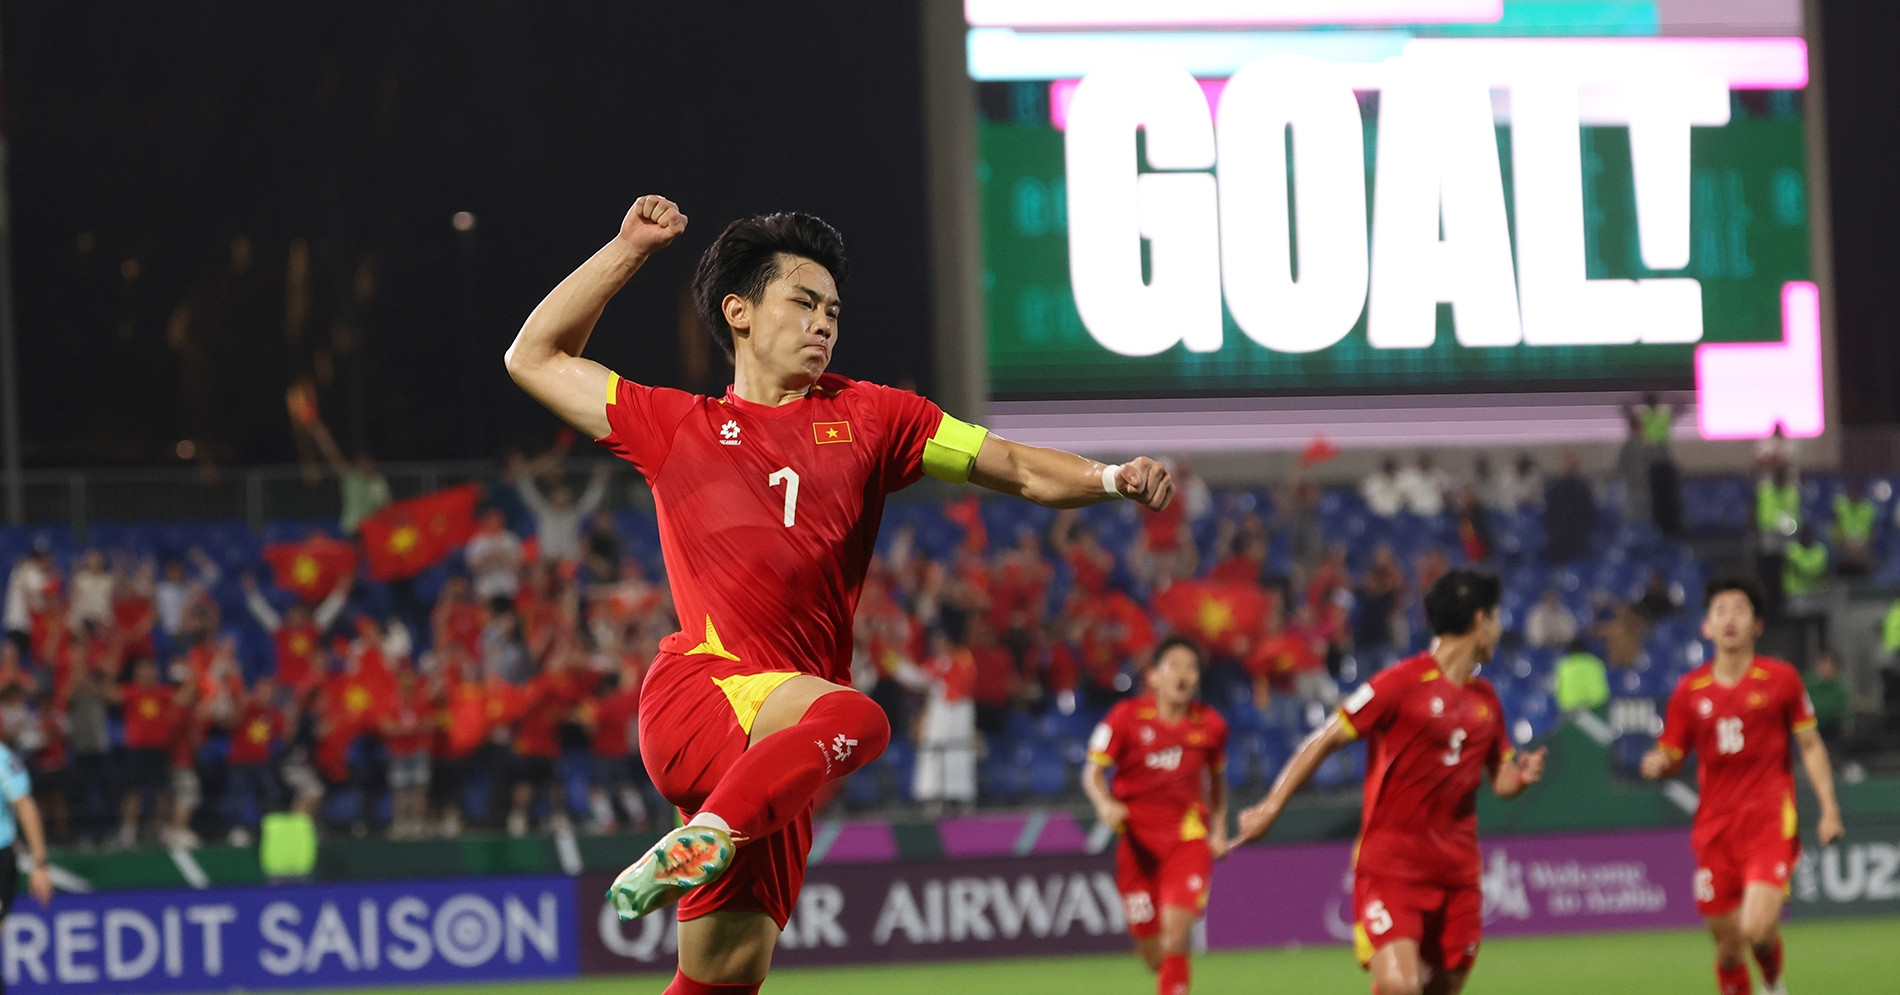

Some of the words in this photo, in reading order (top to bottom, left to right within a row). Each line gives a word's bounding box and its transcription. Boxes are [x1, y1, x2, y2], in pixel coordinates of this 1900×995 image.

[1064, 55, 1730, 356] GOAL!
[769, 466, 800, 528] 7
[1716, 716, 1745, 755] 16
[257, 892, 559, 977] SAISON
[1365, 900, 1394, 936] 5
